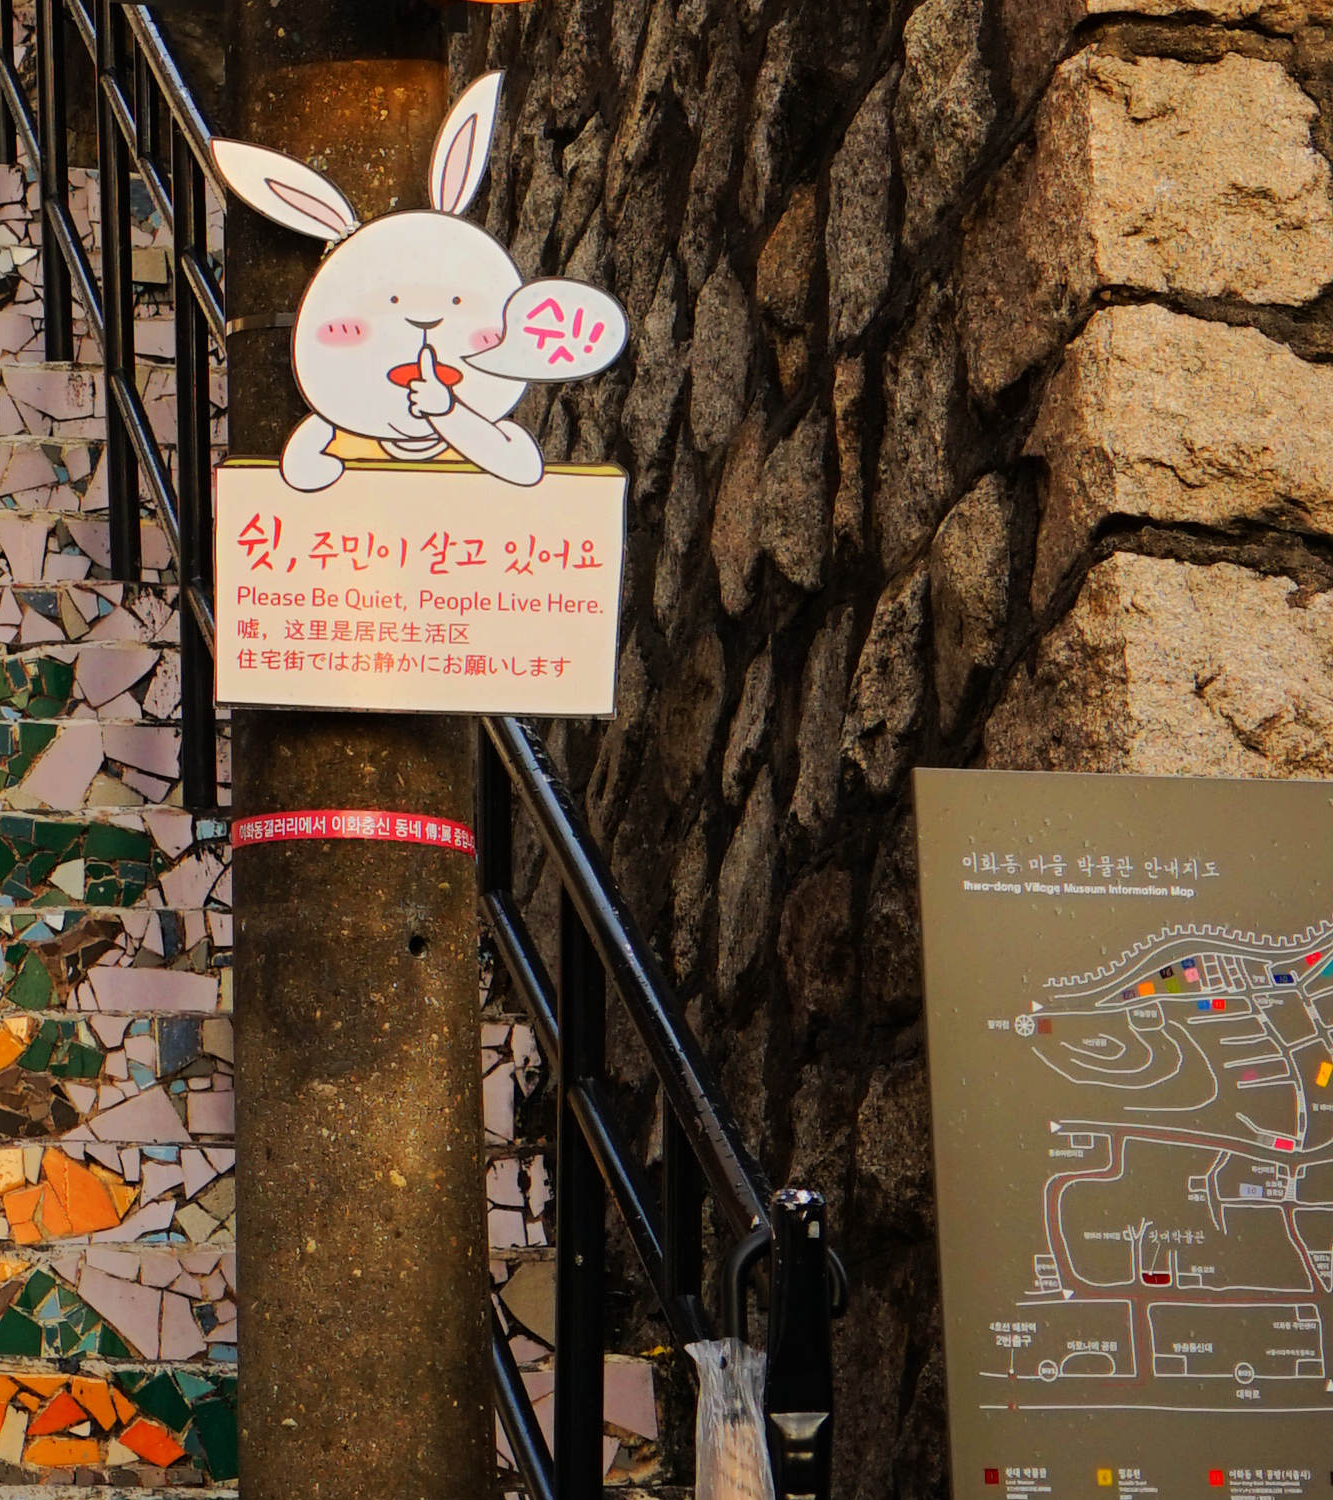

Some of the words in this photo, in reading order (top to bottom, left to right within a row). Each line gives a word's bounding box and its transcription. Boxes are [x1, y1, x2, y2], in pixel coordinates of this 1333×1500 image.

[523, 297, 604, 366] 쉿!
[237, 512, 297, 574] 쉿,
[309, 531, 408, 569] 주민이
[420, 531, 488, 575] 살고
[504, 534, 604, 576] 있어요
[237, 586, 306, 608] Please
[311, 588, 339, 608] Be
[345, 588, 408, 612] Quiet,
[419, 590, 492, 615] People
[497, 592, 542, 613] Live
[548, 594, 604, 615] Here.
[237, 648, 572, 678] 住宅街ではお静かにお願いします
[962, 852, 1021, 875] 이화동
[1028, 854, 1068, 877] 마을
[1077, 855, 1133, 878] 박물관
[1144, 857, 1220, 880] 안내지도
[1024, 882, 1061, 895] Village
[1064, 883, 1106, 895] Museum
[1109, 883, 1168, 896] Information
[1171, 885, 1195, 898] Map
